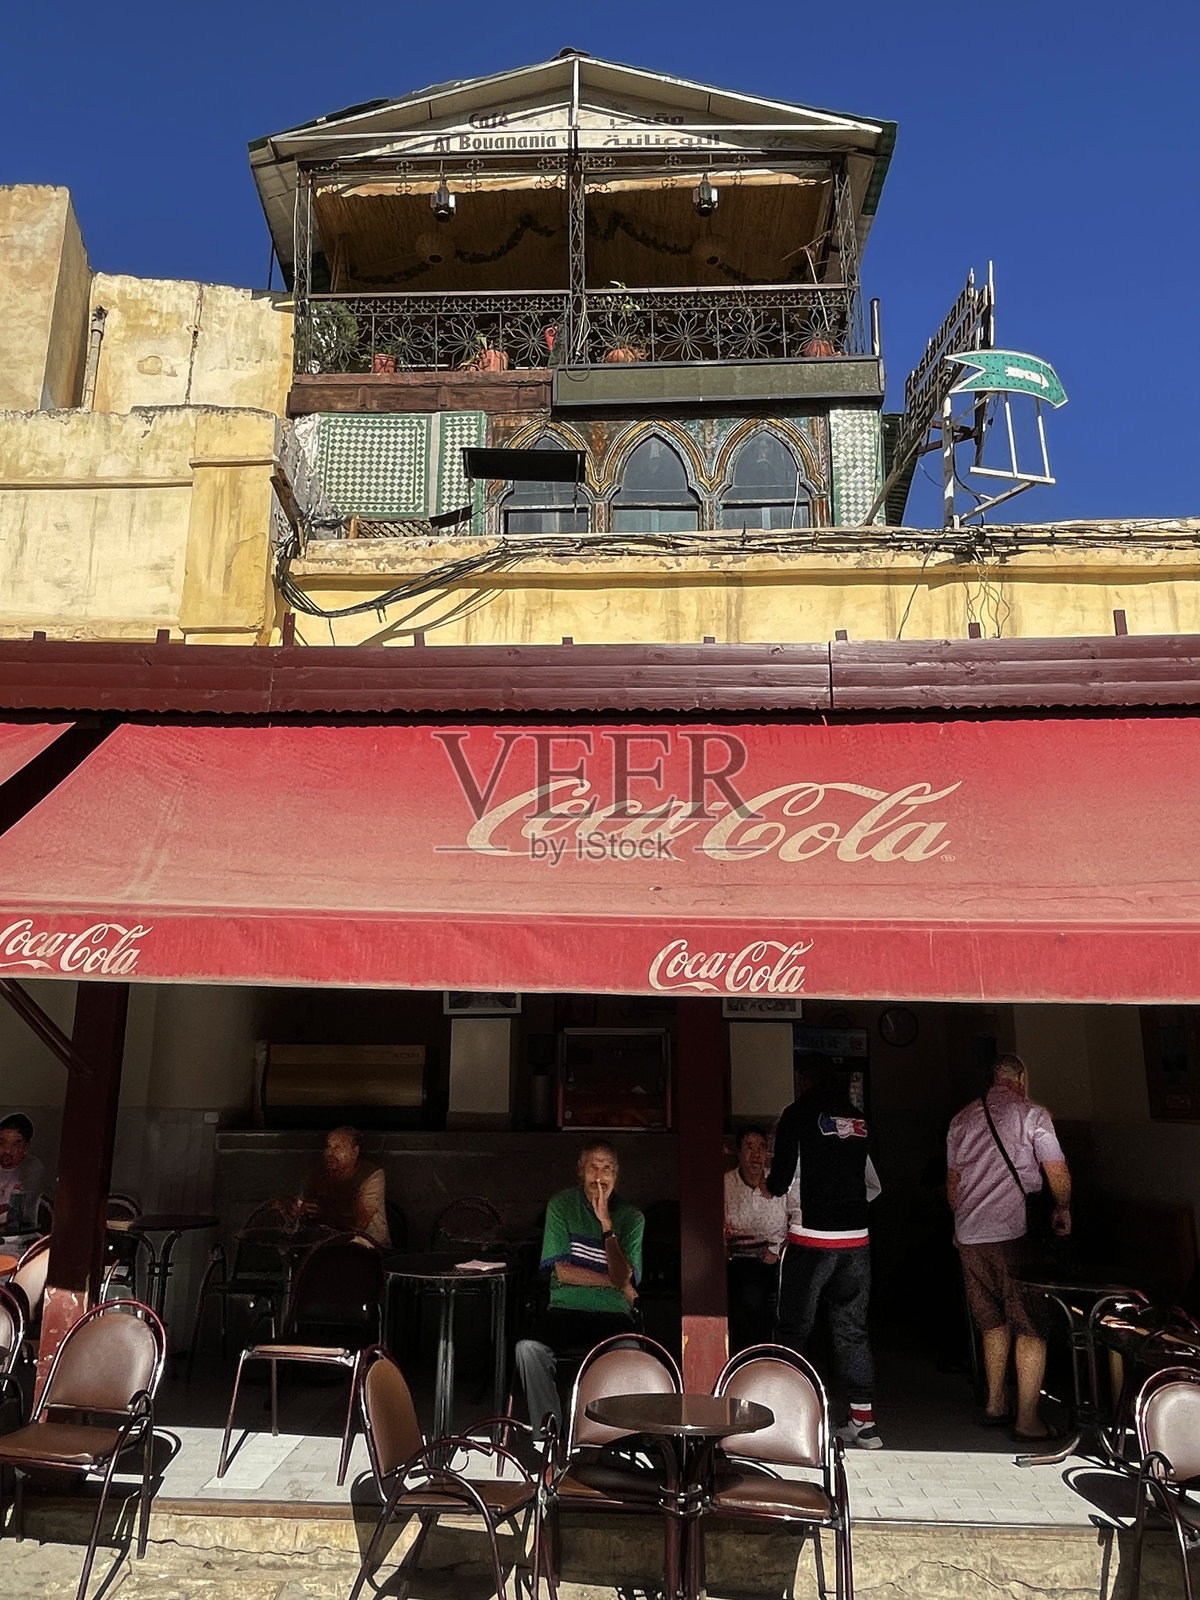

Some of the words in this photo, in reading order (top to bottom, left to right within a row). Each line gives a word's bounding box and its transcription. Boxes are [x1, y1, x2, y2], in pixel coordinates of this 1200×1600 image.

[459, 132, 557, 150] Bouanania
[468, 112, 509, 129] Café
[905, 273, 975, 400] Restaurant
[466, 778, 962, 862] Coca-Cola
[648, 938, 814, 993] Coca-Cola
